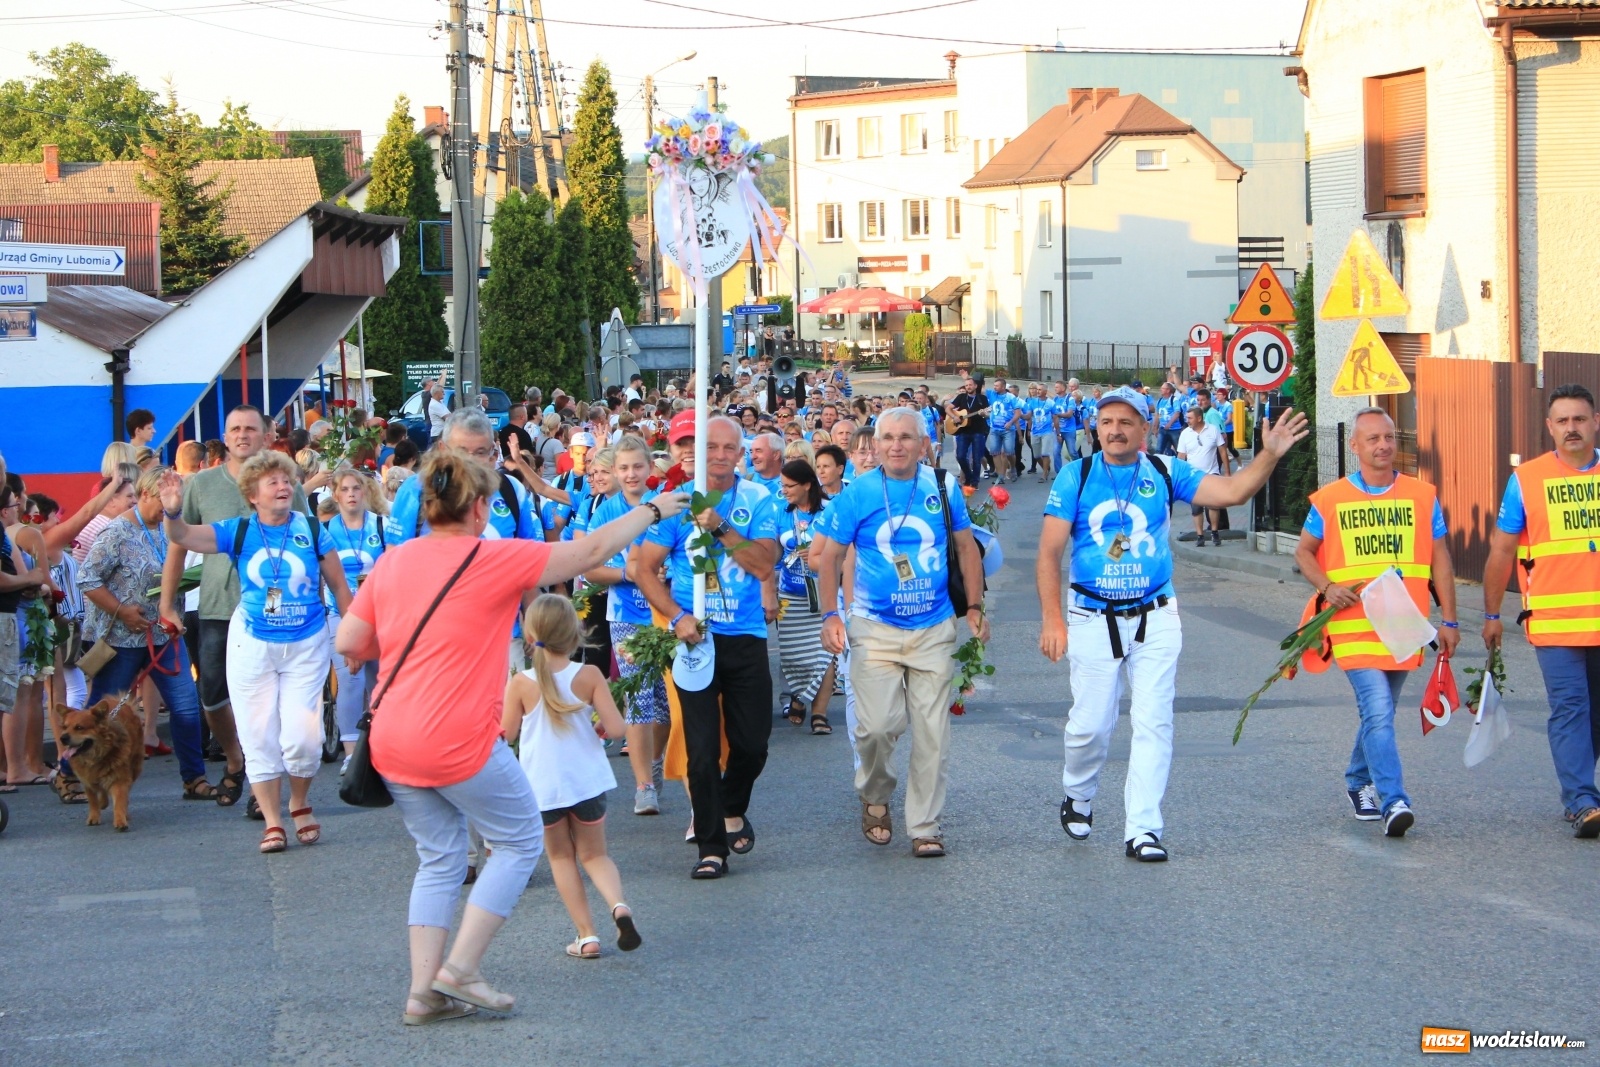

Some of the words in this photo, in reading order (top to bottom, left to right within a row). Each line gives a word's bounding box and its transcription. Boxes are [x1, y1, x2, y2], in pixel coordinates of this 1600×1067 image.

[30, 253, 63, 266] Gminy
[66, 255, 111, 266] Lubomia
[0, 284, 24, 295] owa
[1238, 343, 1284, 373] 30
[1339, 507, 1413, 530] KIEROWANIE
[1354, 534, 1403, 556] RUCHEM
[1102, 563, 1142, 576] JESTEM
[897, 578, 932, 591] JESTEM
[1095, 577, 1150, 591] PAMIĘTAM
[1099, 590, 1145, 600] CZUWAM
